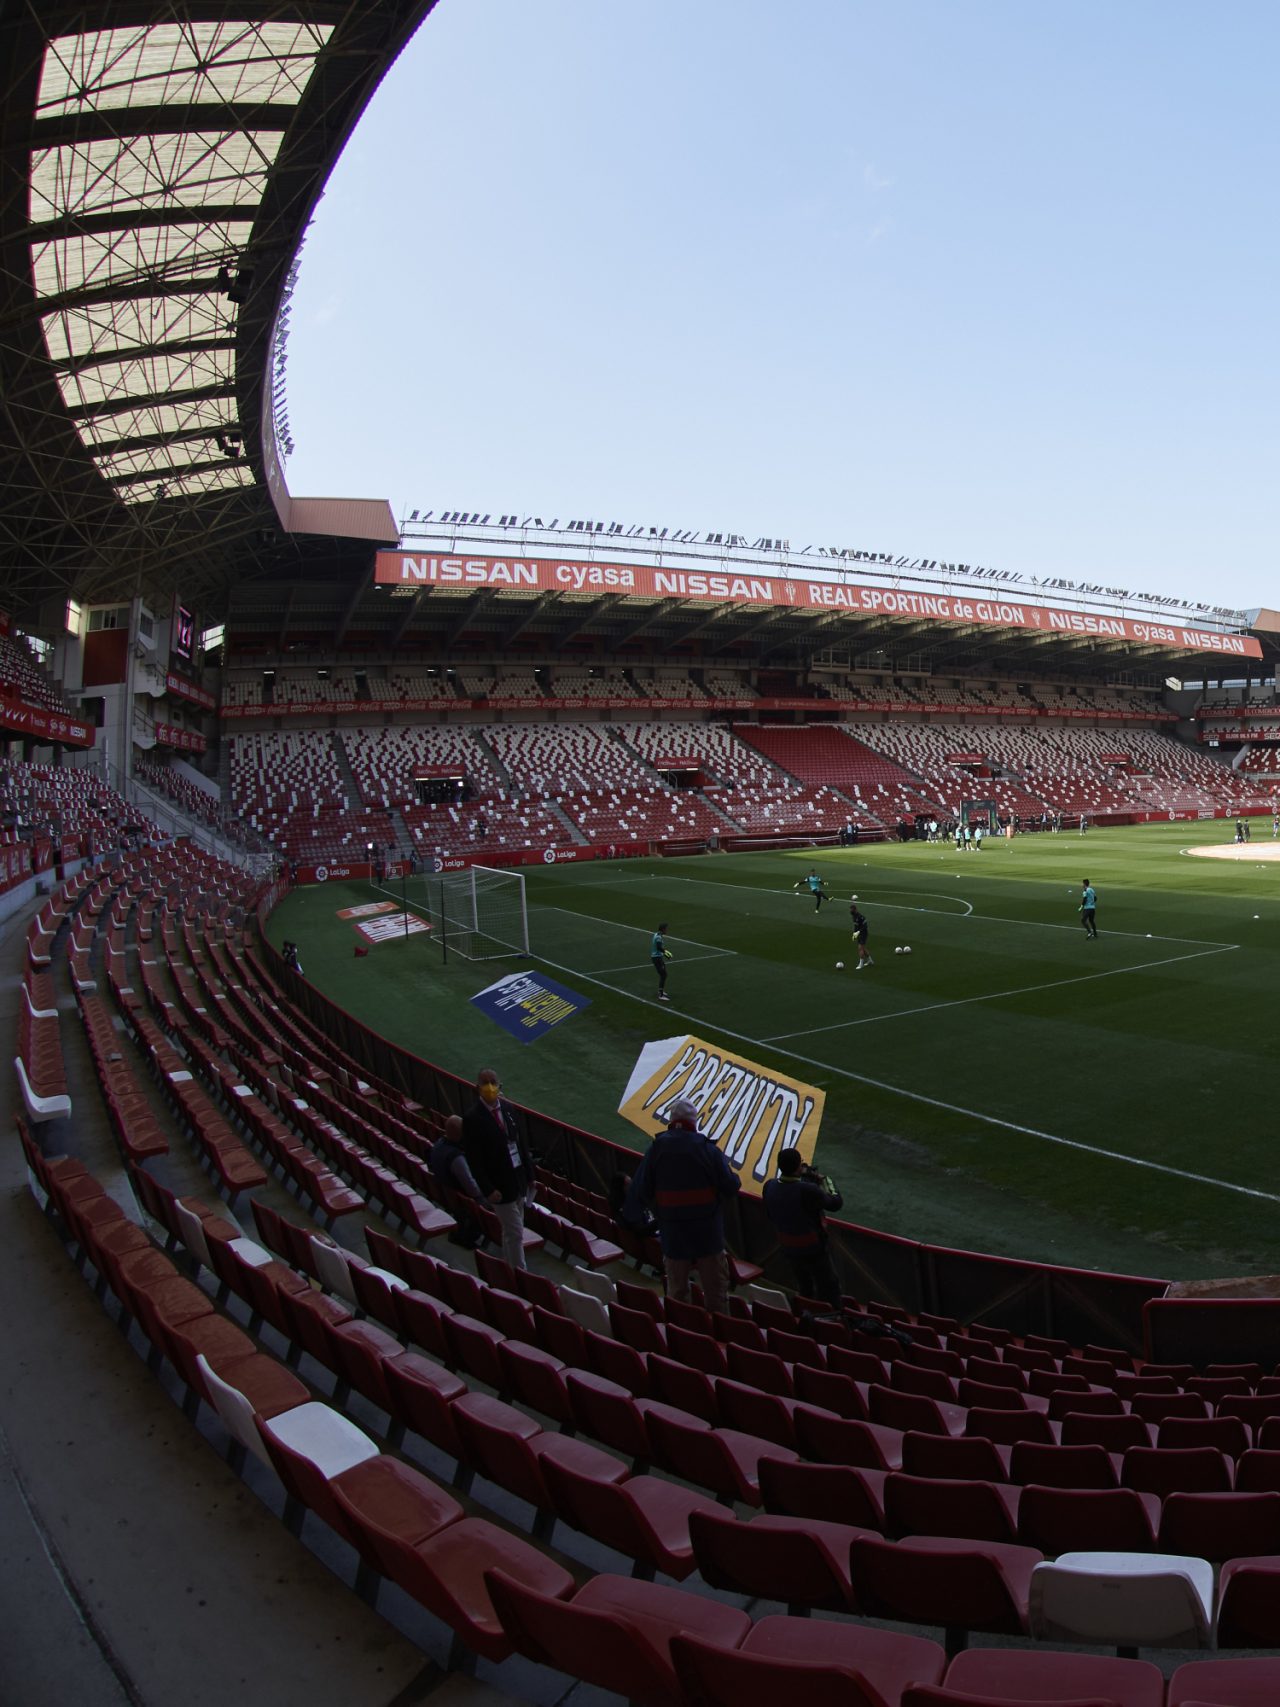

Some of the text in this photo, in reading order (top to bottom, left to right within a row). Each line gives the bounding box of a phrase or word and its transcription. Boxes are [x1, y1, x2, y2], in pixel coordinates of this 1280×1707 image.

[402, 558, 1244, 653] NISSAN cyasa NISSAN REAL SPORTING de GIJON NISSAN cyasa NISSAN
[557, 851, 576, 859] LaLiga
[445, 859, 464, 868] LaLiga
[329, 868, 350, 876] LaLiga
